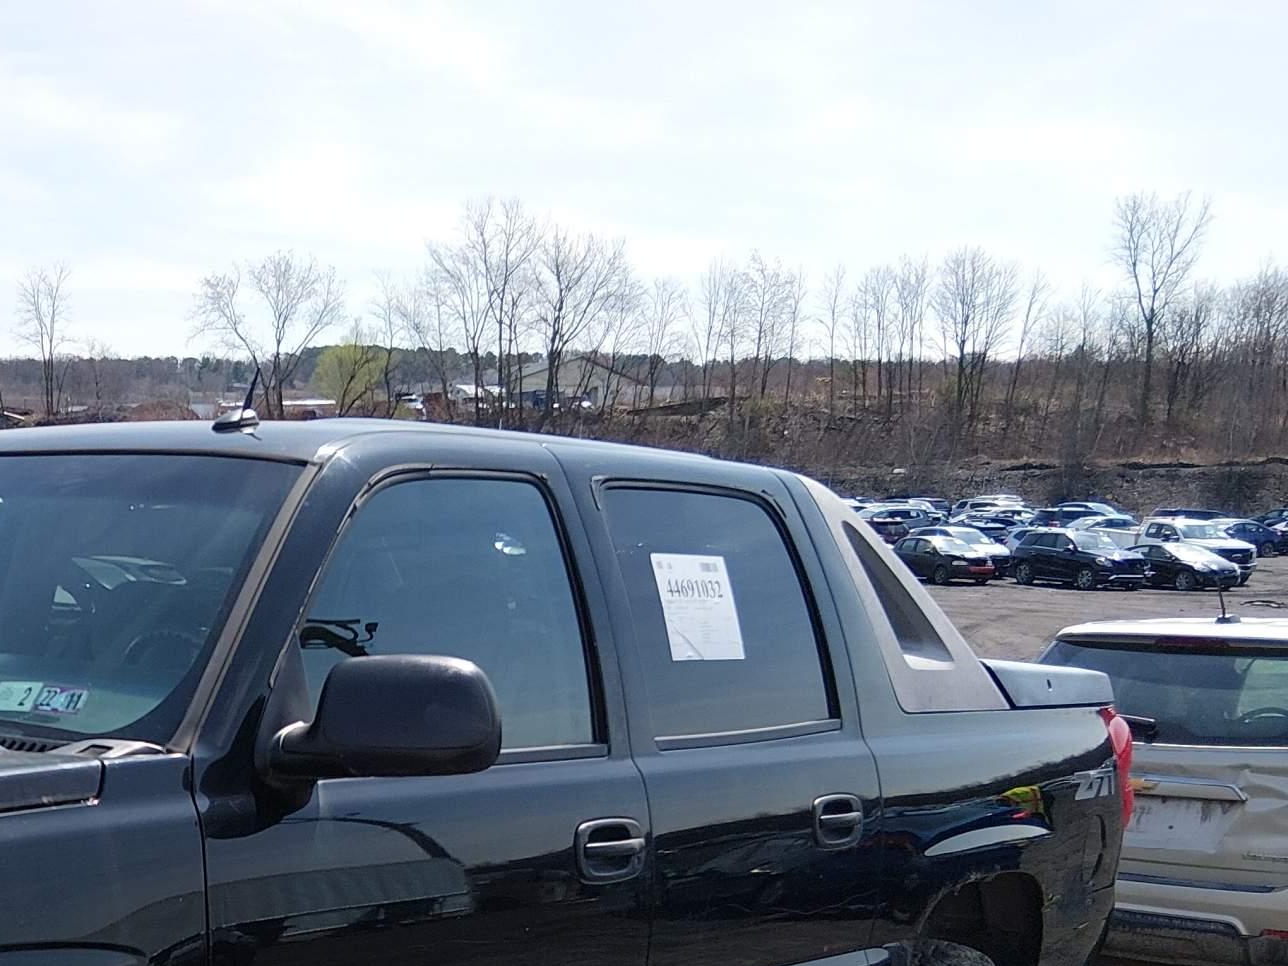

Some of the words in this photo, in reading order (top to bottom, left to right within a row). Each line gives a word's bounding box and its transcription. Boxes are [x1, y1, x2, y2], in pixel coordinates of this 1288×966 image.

[667, 579, 723, 598] 44691032
[17, 686, 33, 706] 2
[39, 690, 57, 707] 22
